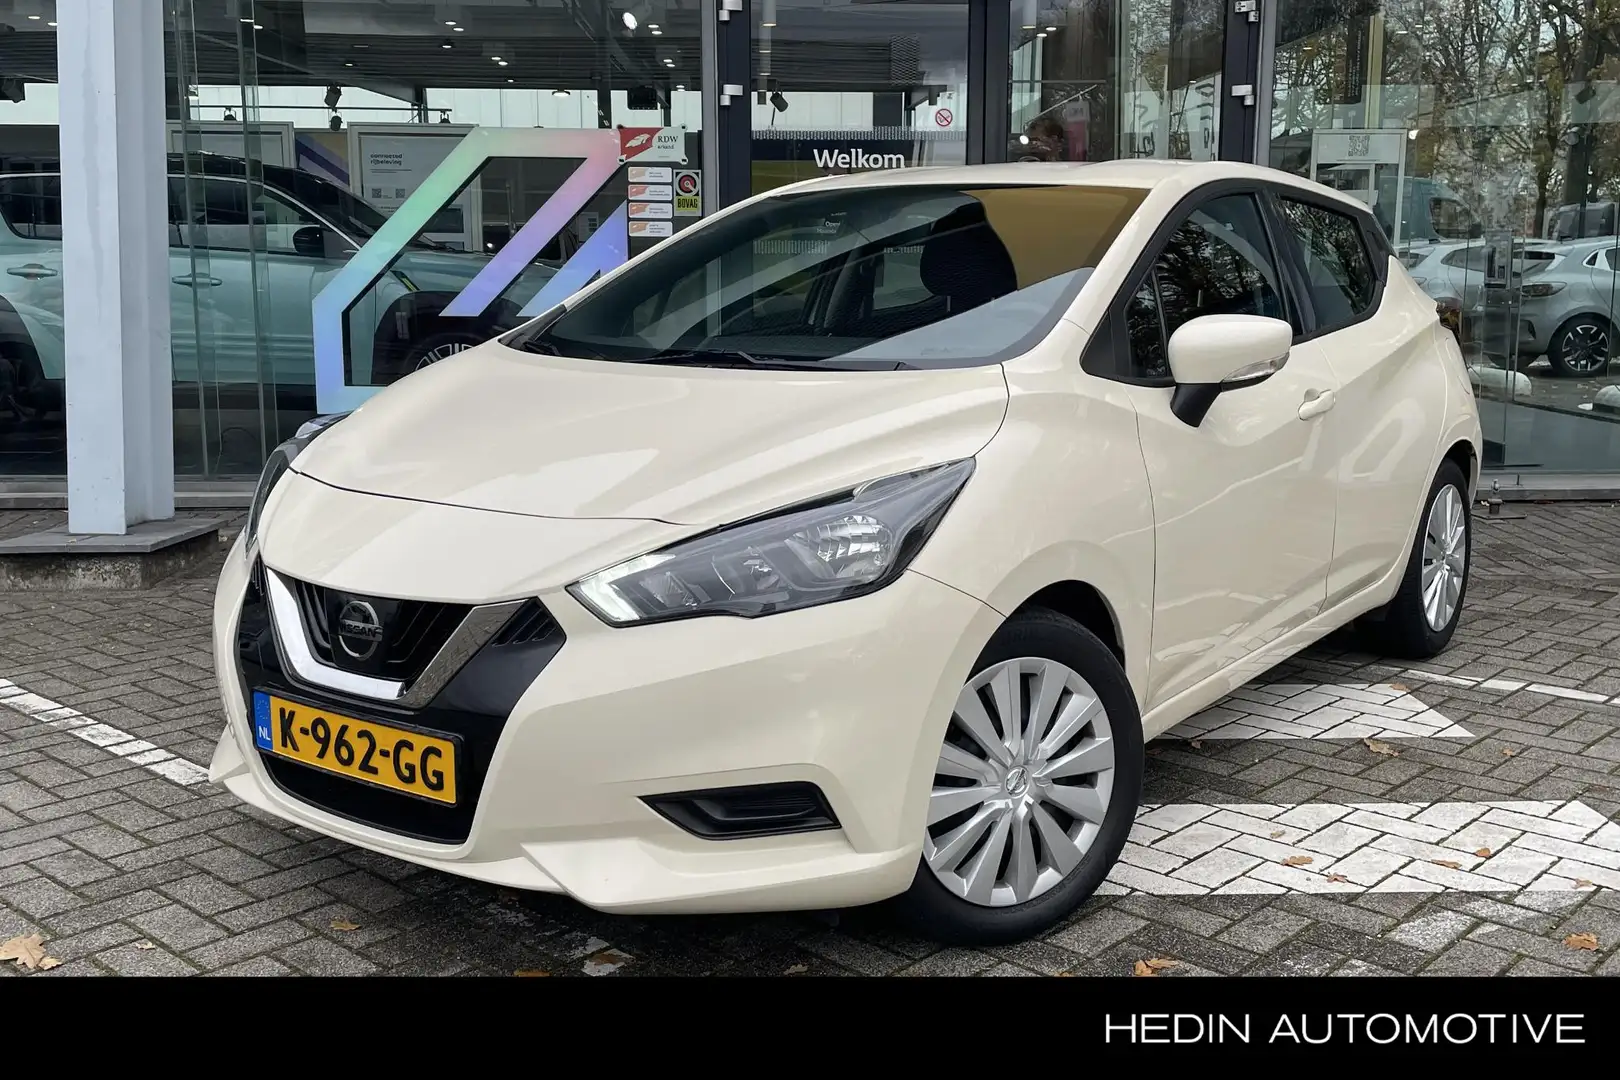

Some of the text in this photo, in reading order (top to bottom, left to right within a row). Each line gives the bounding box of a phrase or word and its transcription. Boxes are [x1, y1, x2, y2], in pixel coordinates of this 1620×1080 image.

[657, 135, 679, 143] RDW
[812, 148, 905, 168] Welkom
[677, 198, 698, 208] BOVAG
[258, 724, 272, 741] NL
[279, 706, 445, 792] K-962-GG
